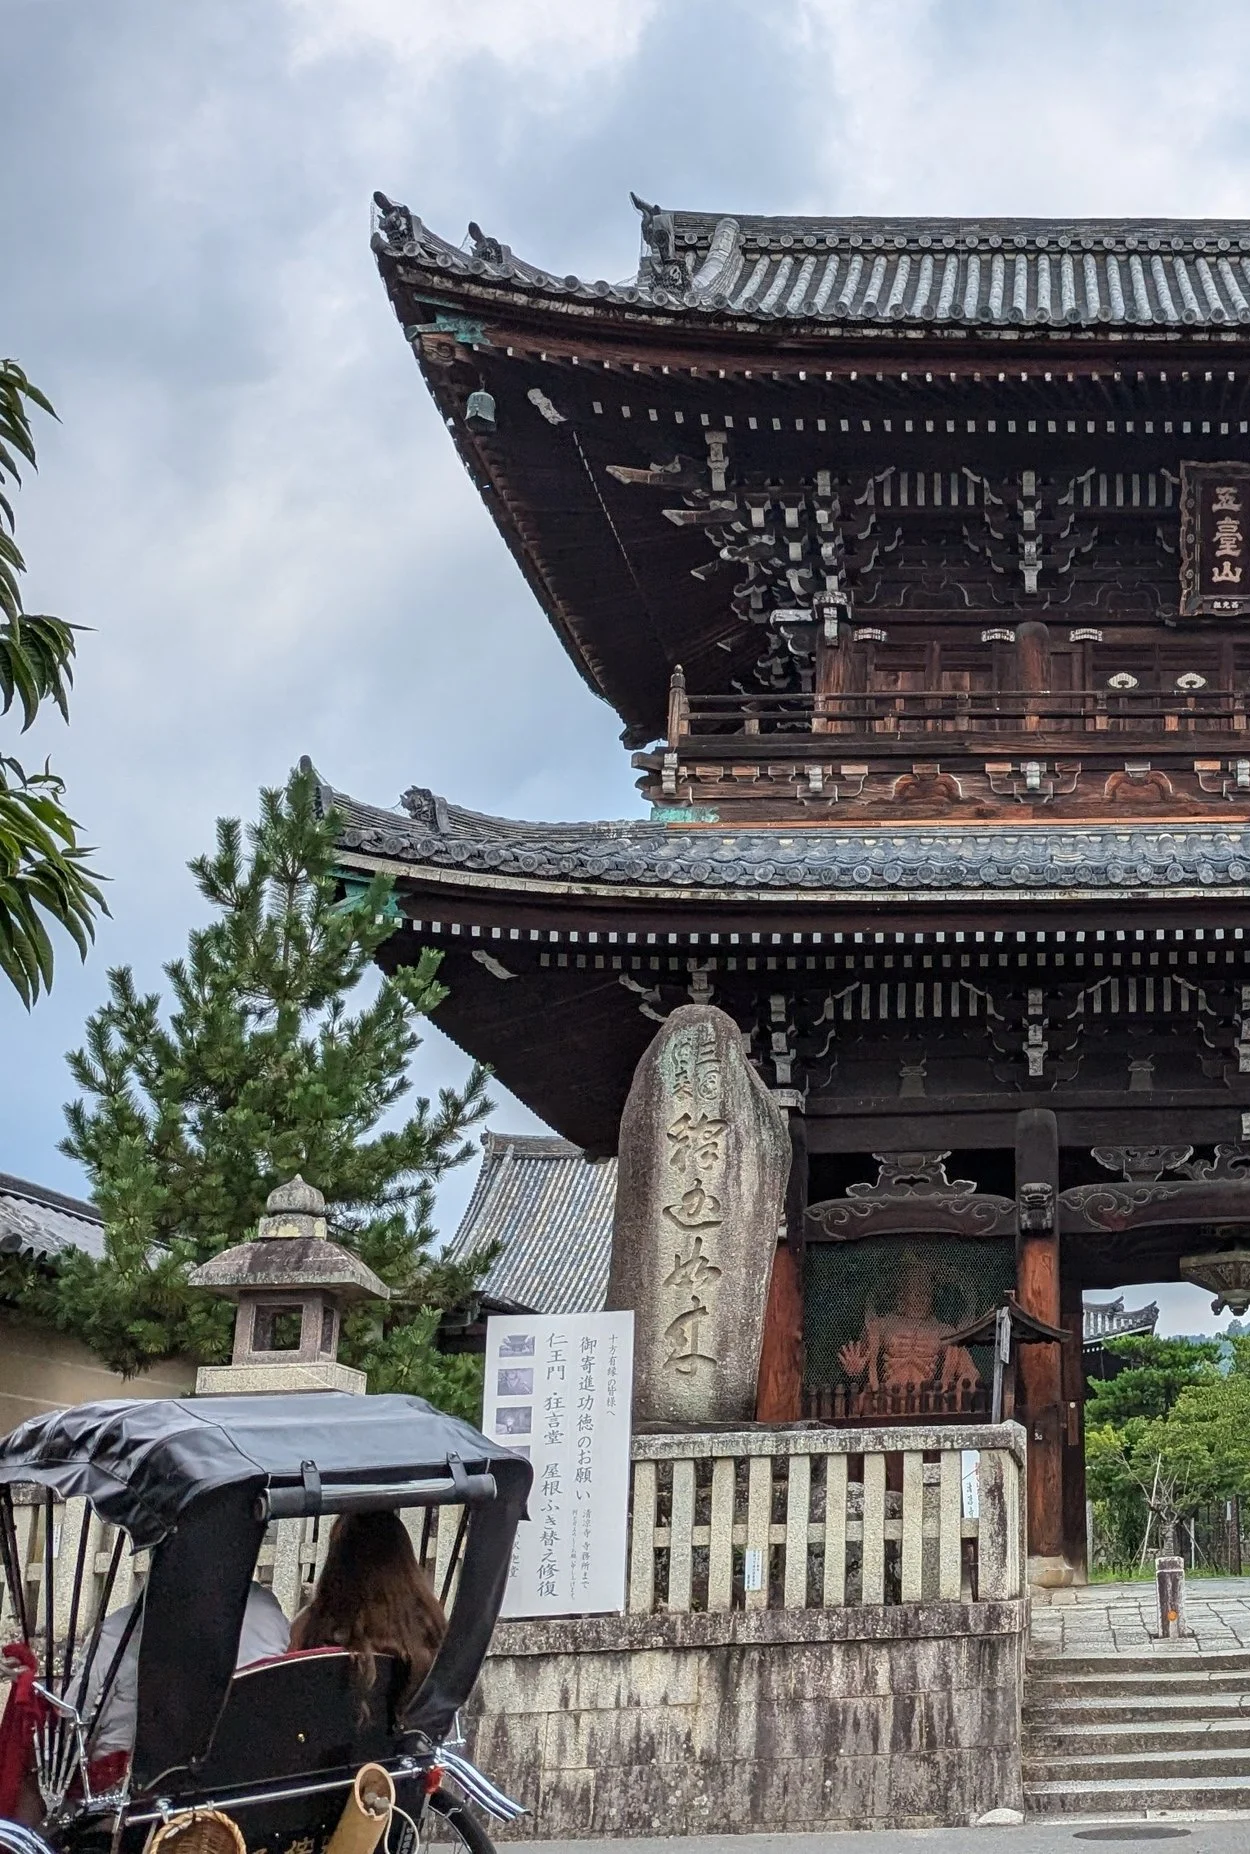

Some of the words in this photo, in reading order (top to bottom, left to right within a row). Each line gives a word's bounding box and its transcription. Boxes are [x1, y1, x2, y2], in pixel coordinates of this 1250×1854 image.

[543, 1332, 568, 1446] 仁王門・狂言堂
[575, 1336, 597, 1501] 御寄進功徳のお願い
[537, 1463, 563, 1598] 屋根ふき替え修復
